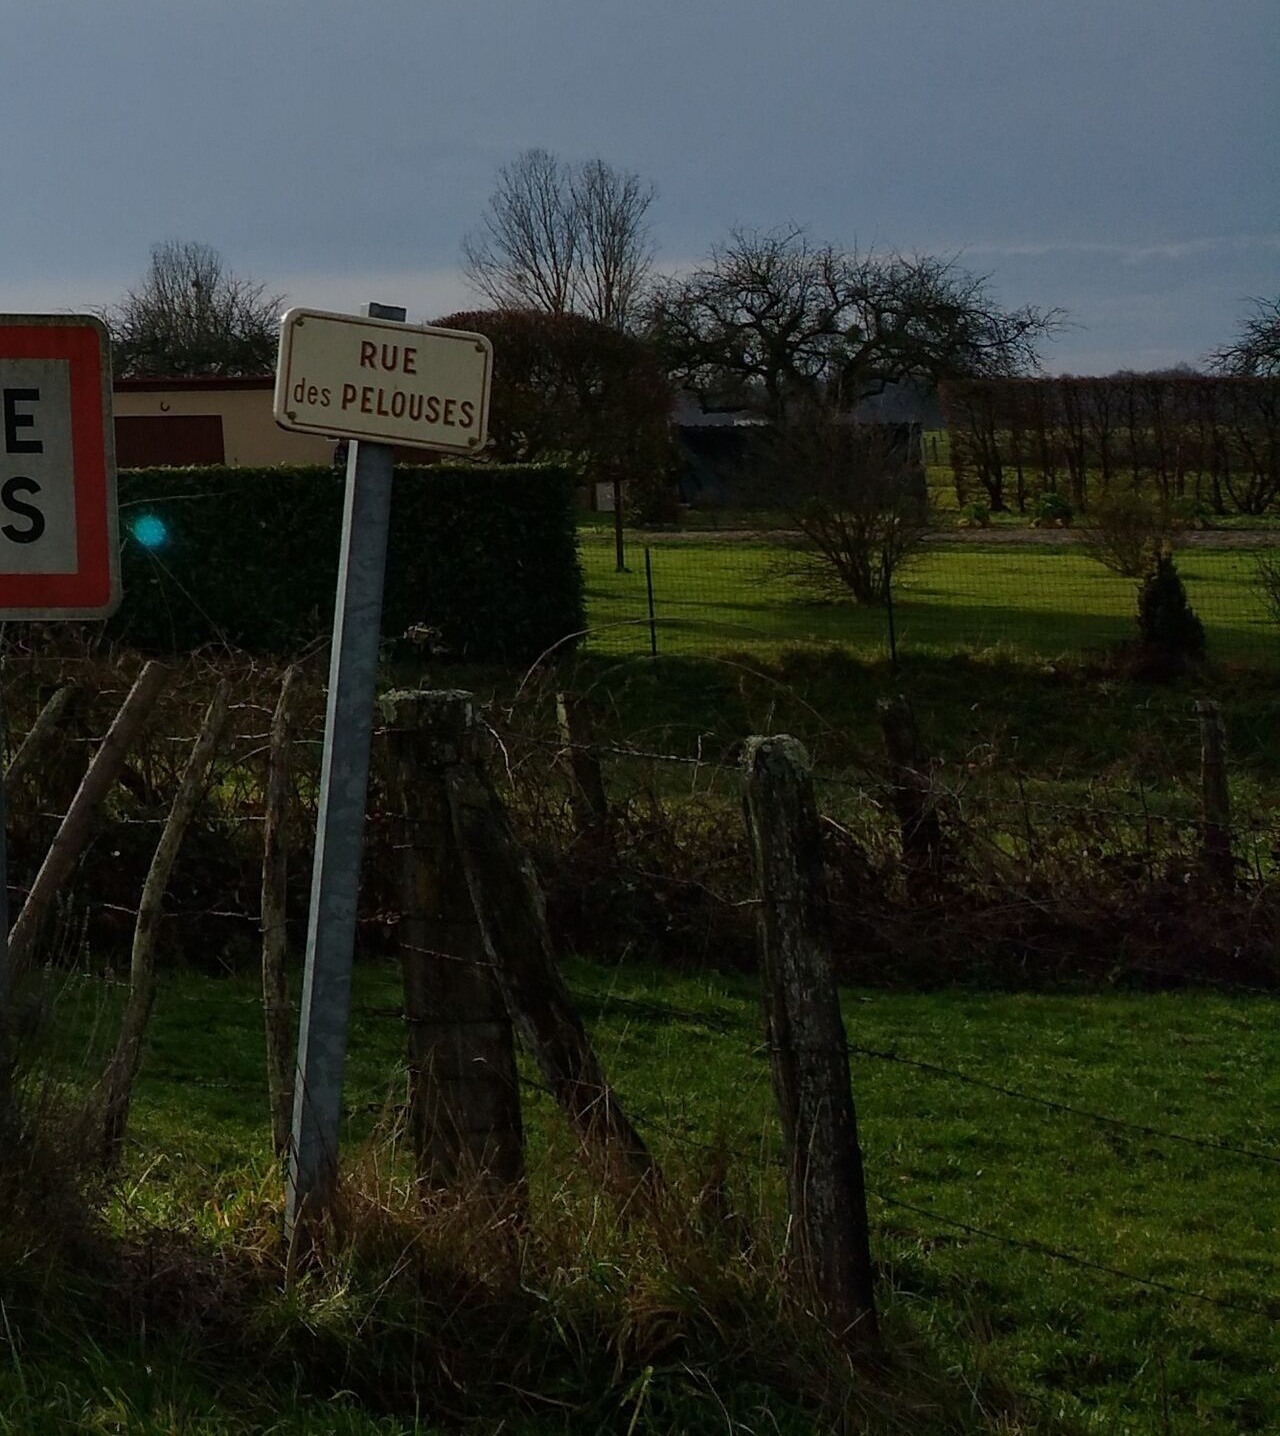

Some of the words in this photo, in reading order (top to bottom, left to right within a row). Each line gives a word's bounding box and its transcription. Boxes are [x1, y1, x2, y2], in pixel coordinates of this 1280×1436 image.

[359, 340, 418, 375] RUE
[293, 377, 332, 408] des
[341, 383, 475, 429] PELOUSES
